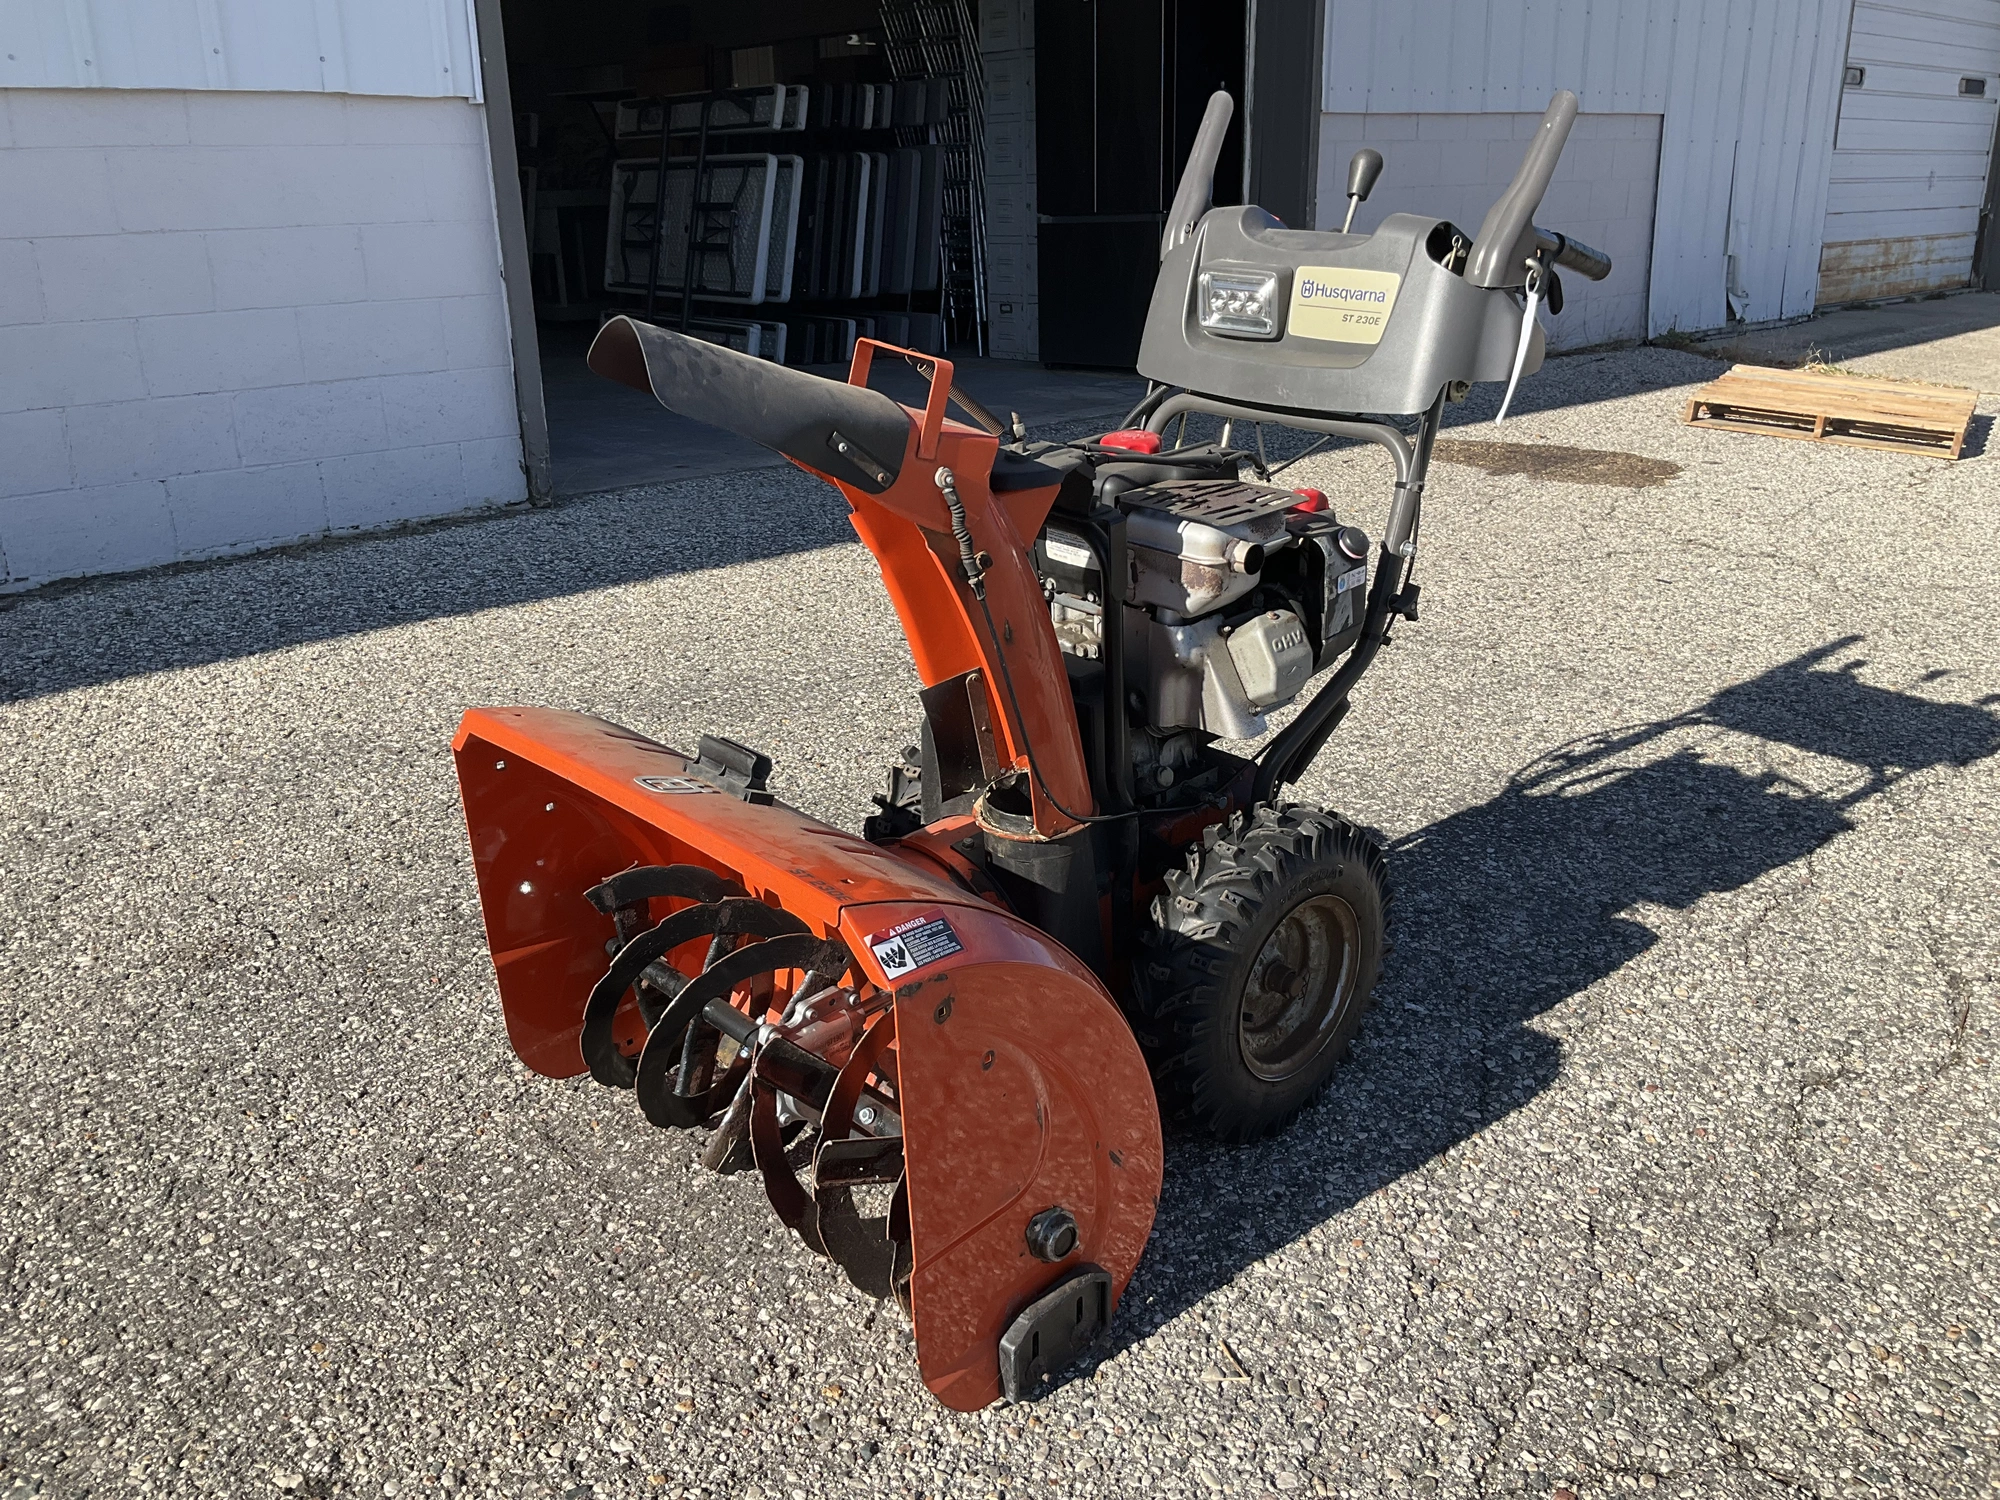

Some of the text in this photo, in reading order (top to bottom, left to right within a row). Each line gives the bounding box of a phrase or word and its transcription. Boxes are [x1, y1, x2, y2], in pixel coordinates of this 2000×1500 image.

[1315, 283, 1385, 302] Husqvarna
[1342, 314, 1381, 326] ST 230E
[1272, 629, 1303, 653] OHV
[790, 869, 815, 878] ST
[895, 917, 926, 934] DANGER
